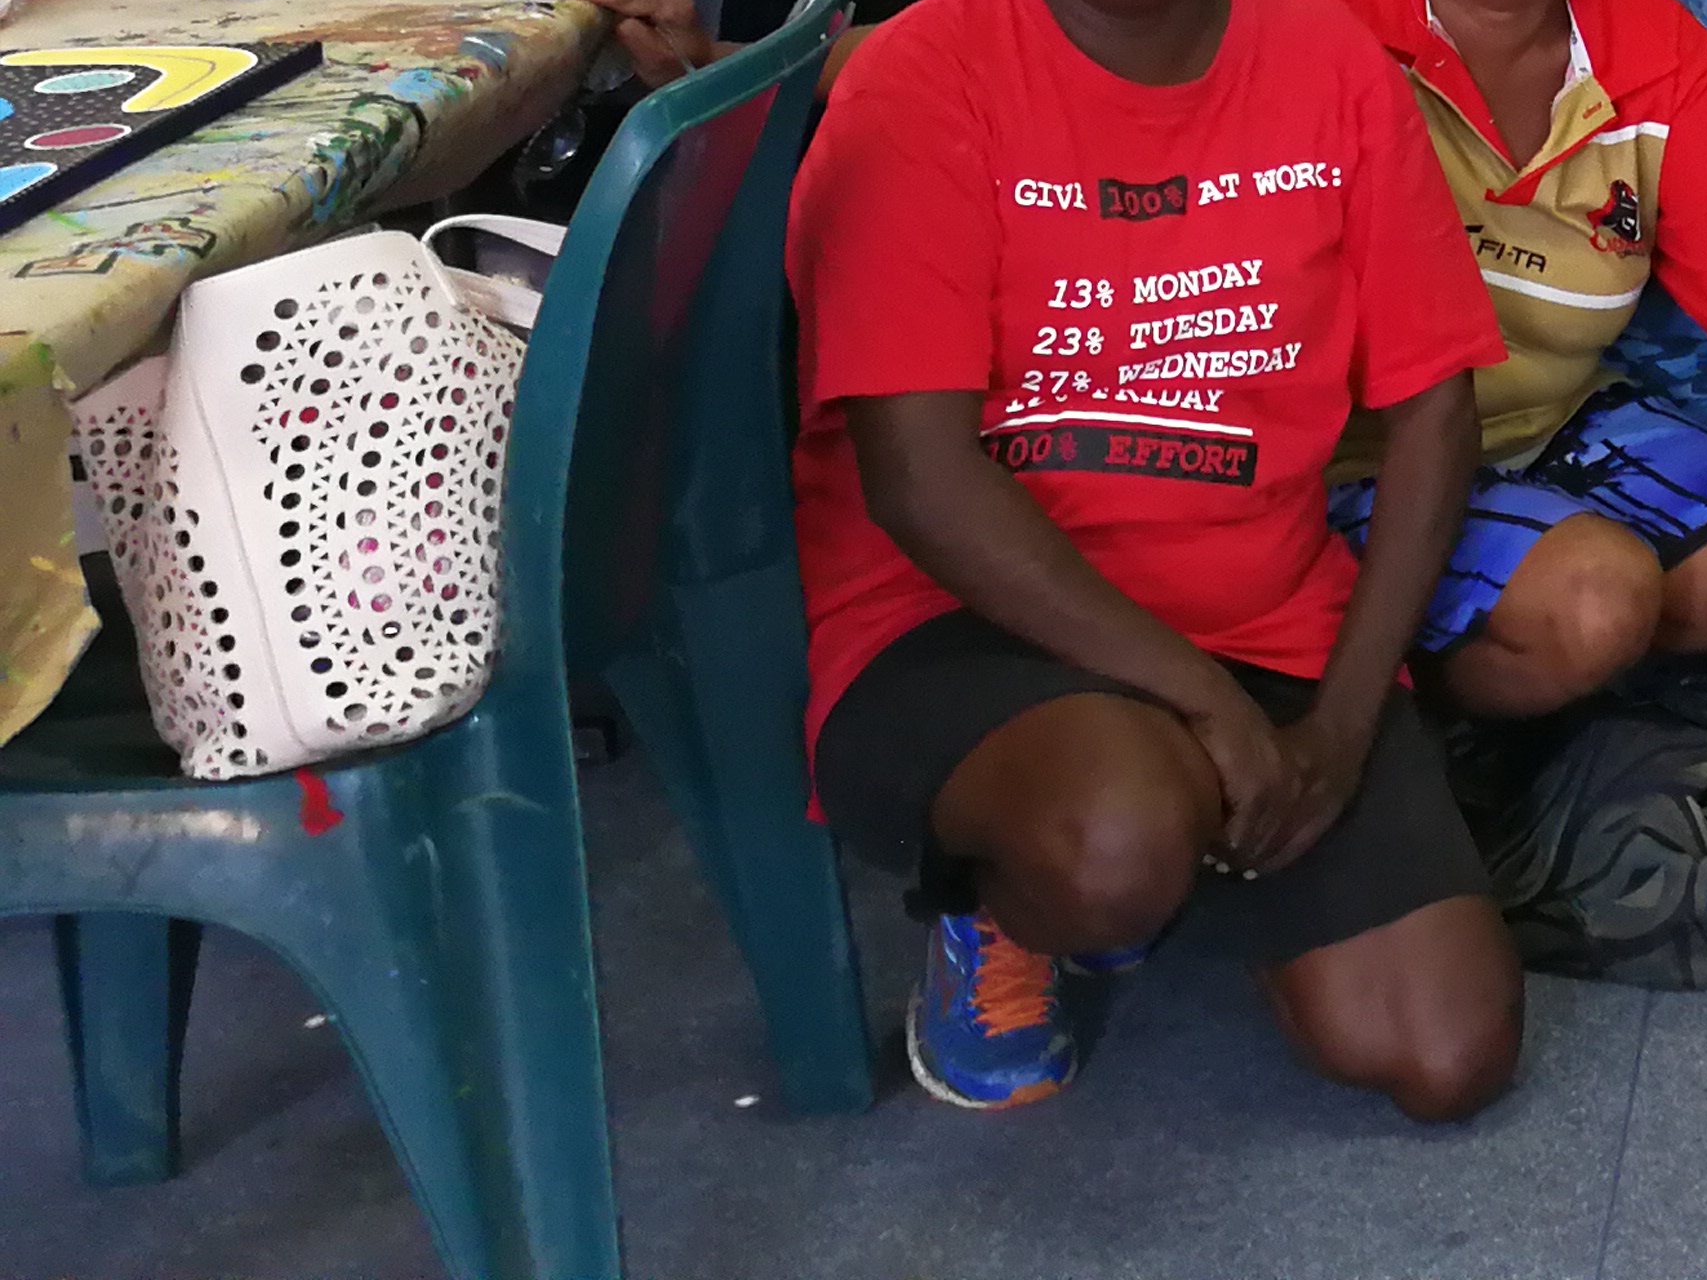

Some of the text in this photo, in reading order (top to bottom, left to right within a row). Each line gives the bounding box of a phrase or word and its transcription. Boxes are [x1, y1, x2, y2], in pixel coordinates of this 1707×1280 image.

[1106, 183, 1186, 217] 100%
[1198, 172, 1241, 206] AT
[1048, 259, 1264, 310] 13% MONDAY
[1032, 302, 1279, 357] 23% TUESDAY
[1020, 342, 1303, 396] 27% WEDNESDAY
[1104, 436, 1248, 478] EFFORT
